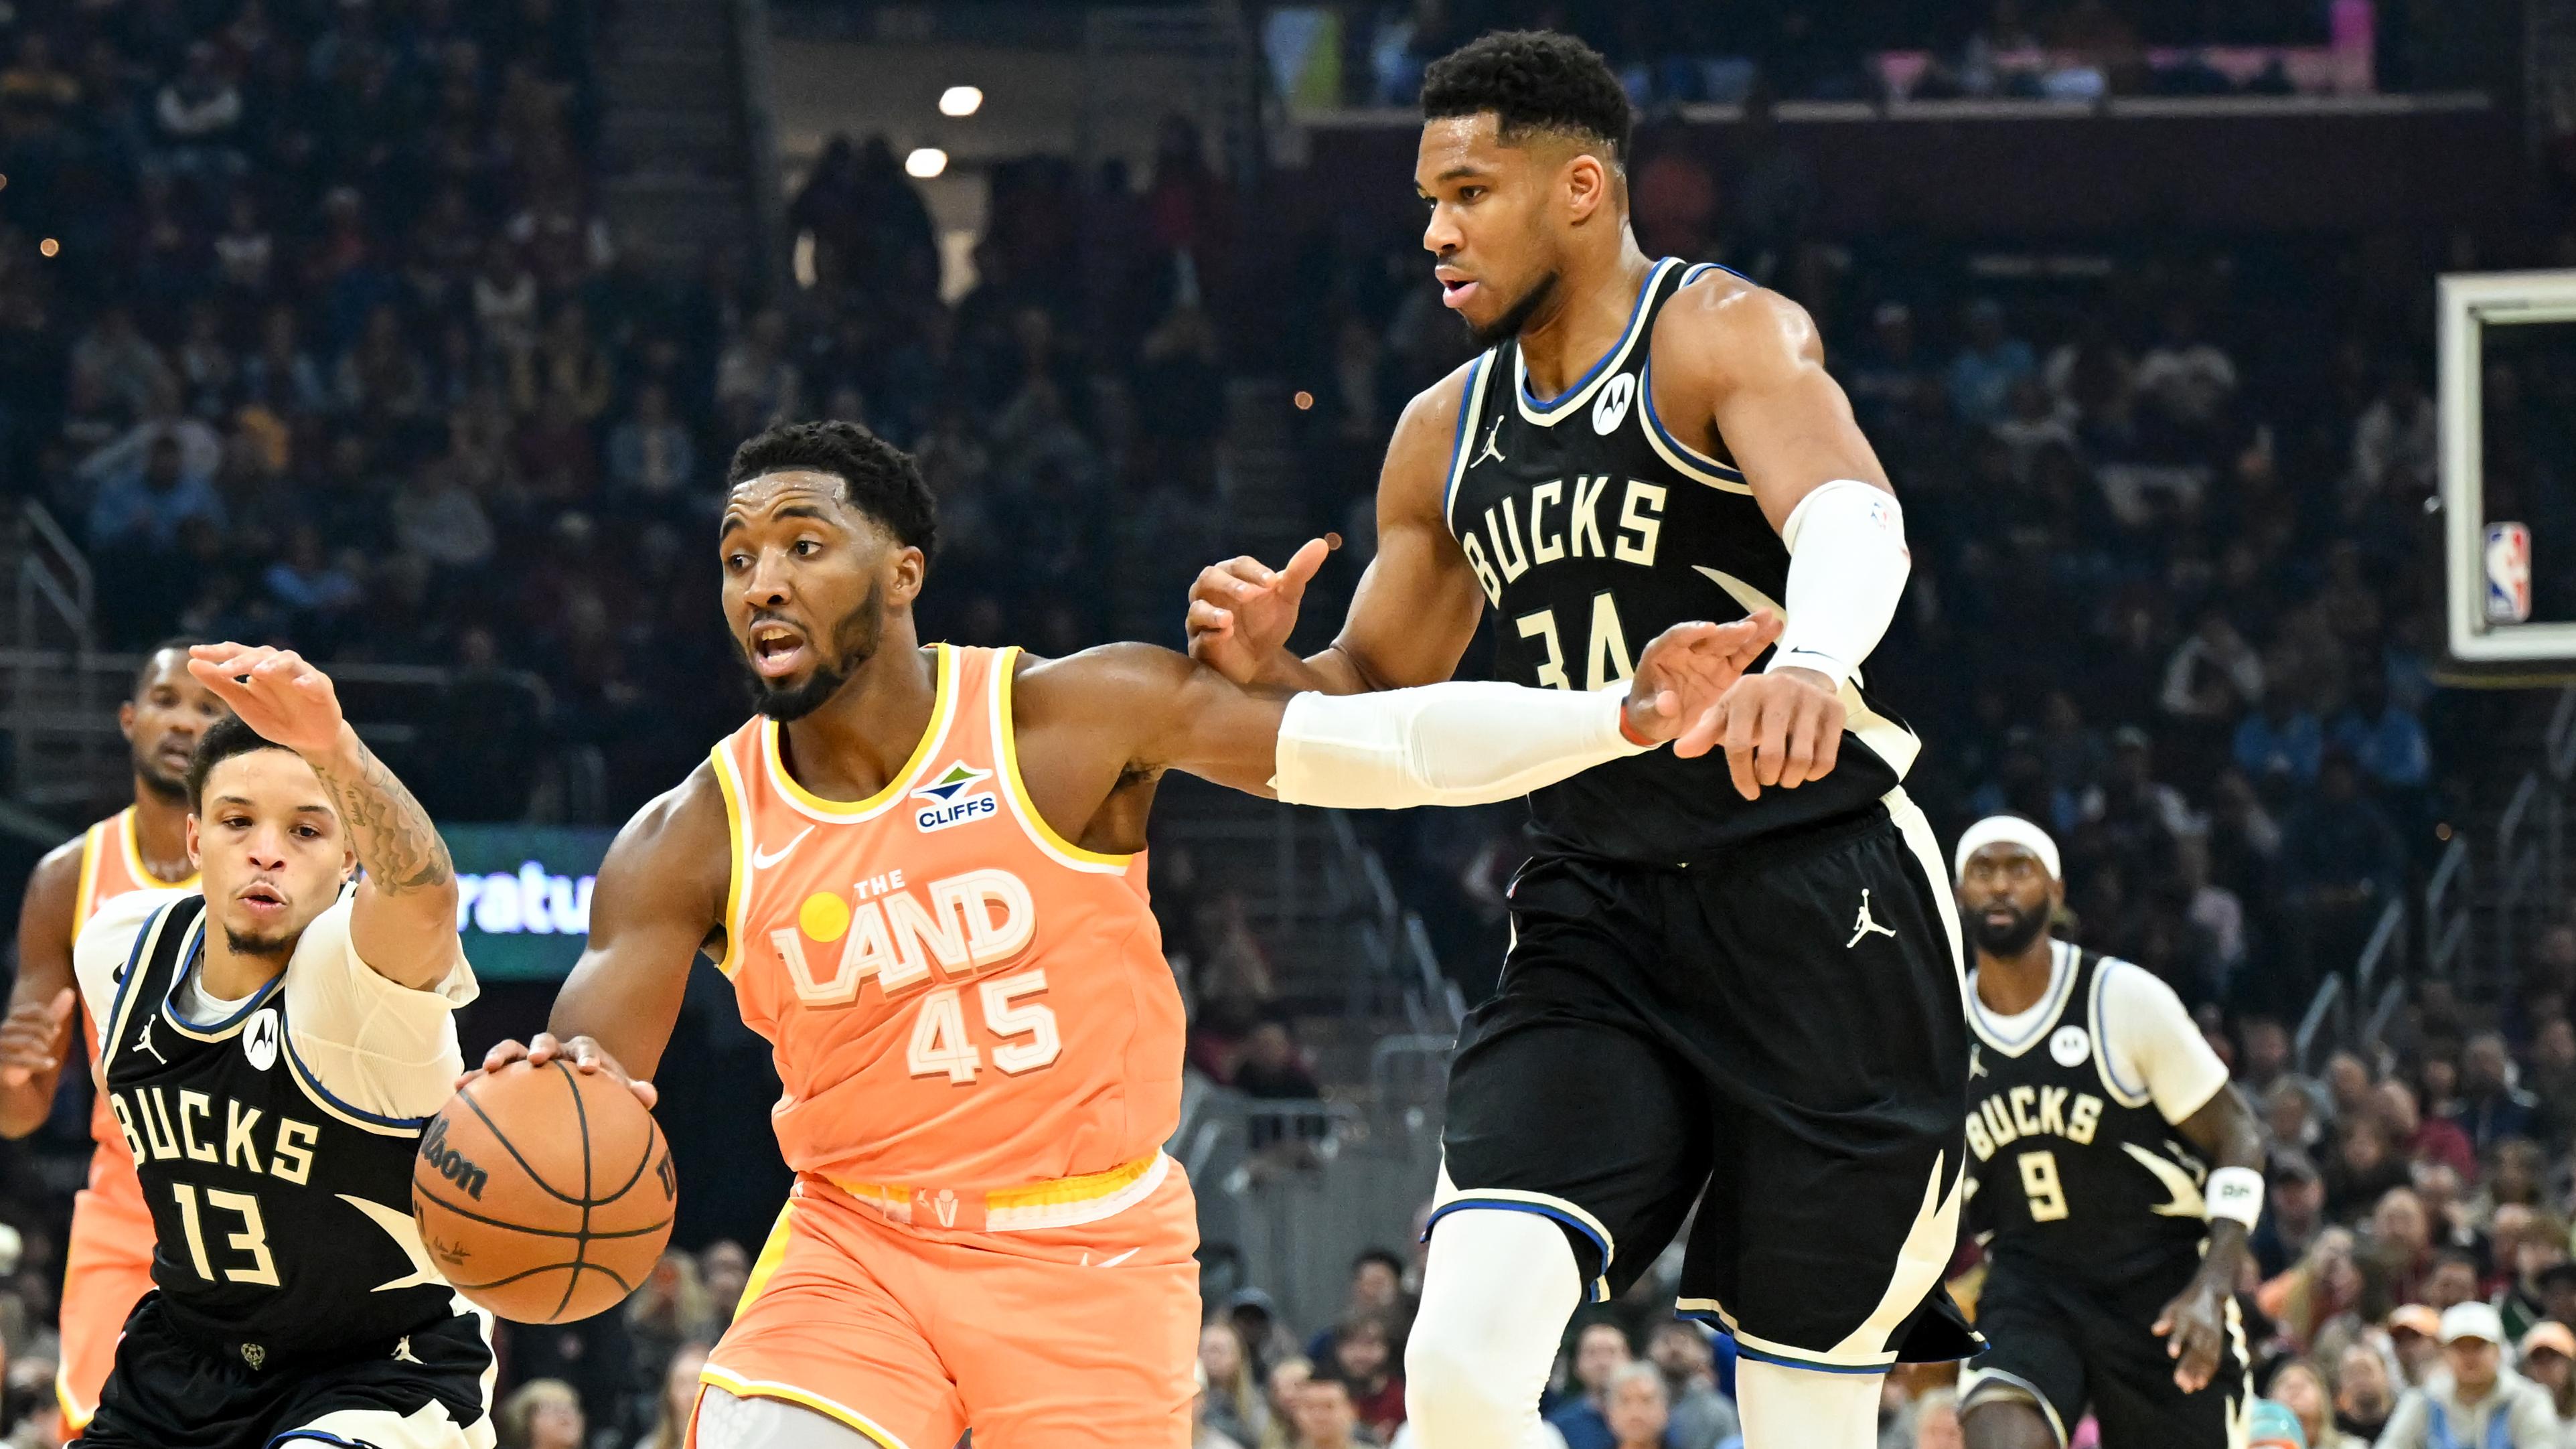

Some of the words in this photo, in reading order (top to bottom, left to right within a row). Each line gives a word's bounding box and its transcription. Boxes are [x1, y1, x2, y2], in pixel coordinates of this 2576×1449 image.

[1462, 475, 1668, 610] BUCKS
[1515, 592, 1635, 691] 34
[919, 797, 995, 828] CLIFFS
[854, 869, 906, 899] THE
[770, 868, 1038, 1011] LAND
[906, 968, 1063, 1087] 45
[110, 1085, 321, 1187] BUCKS
[1965, 1084, 2104, 1162] BUCKS
[172, 1183, 281, 1288] 13
[2016, 1149, 2070, 1223] 9
